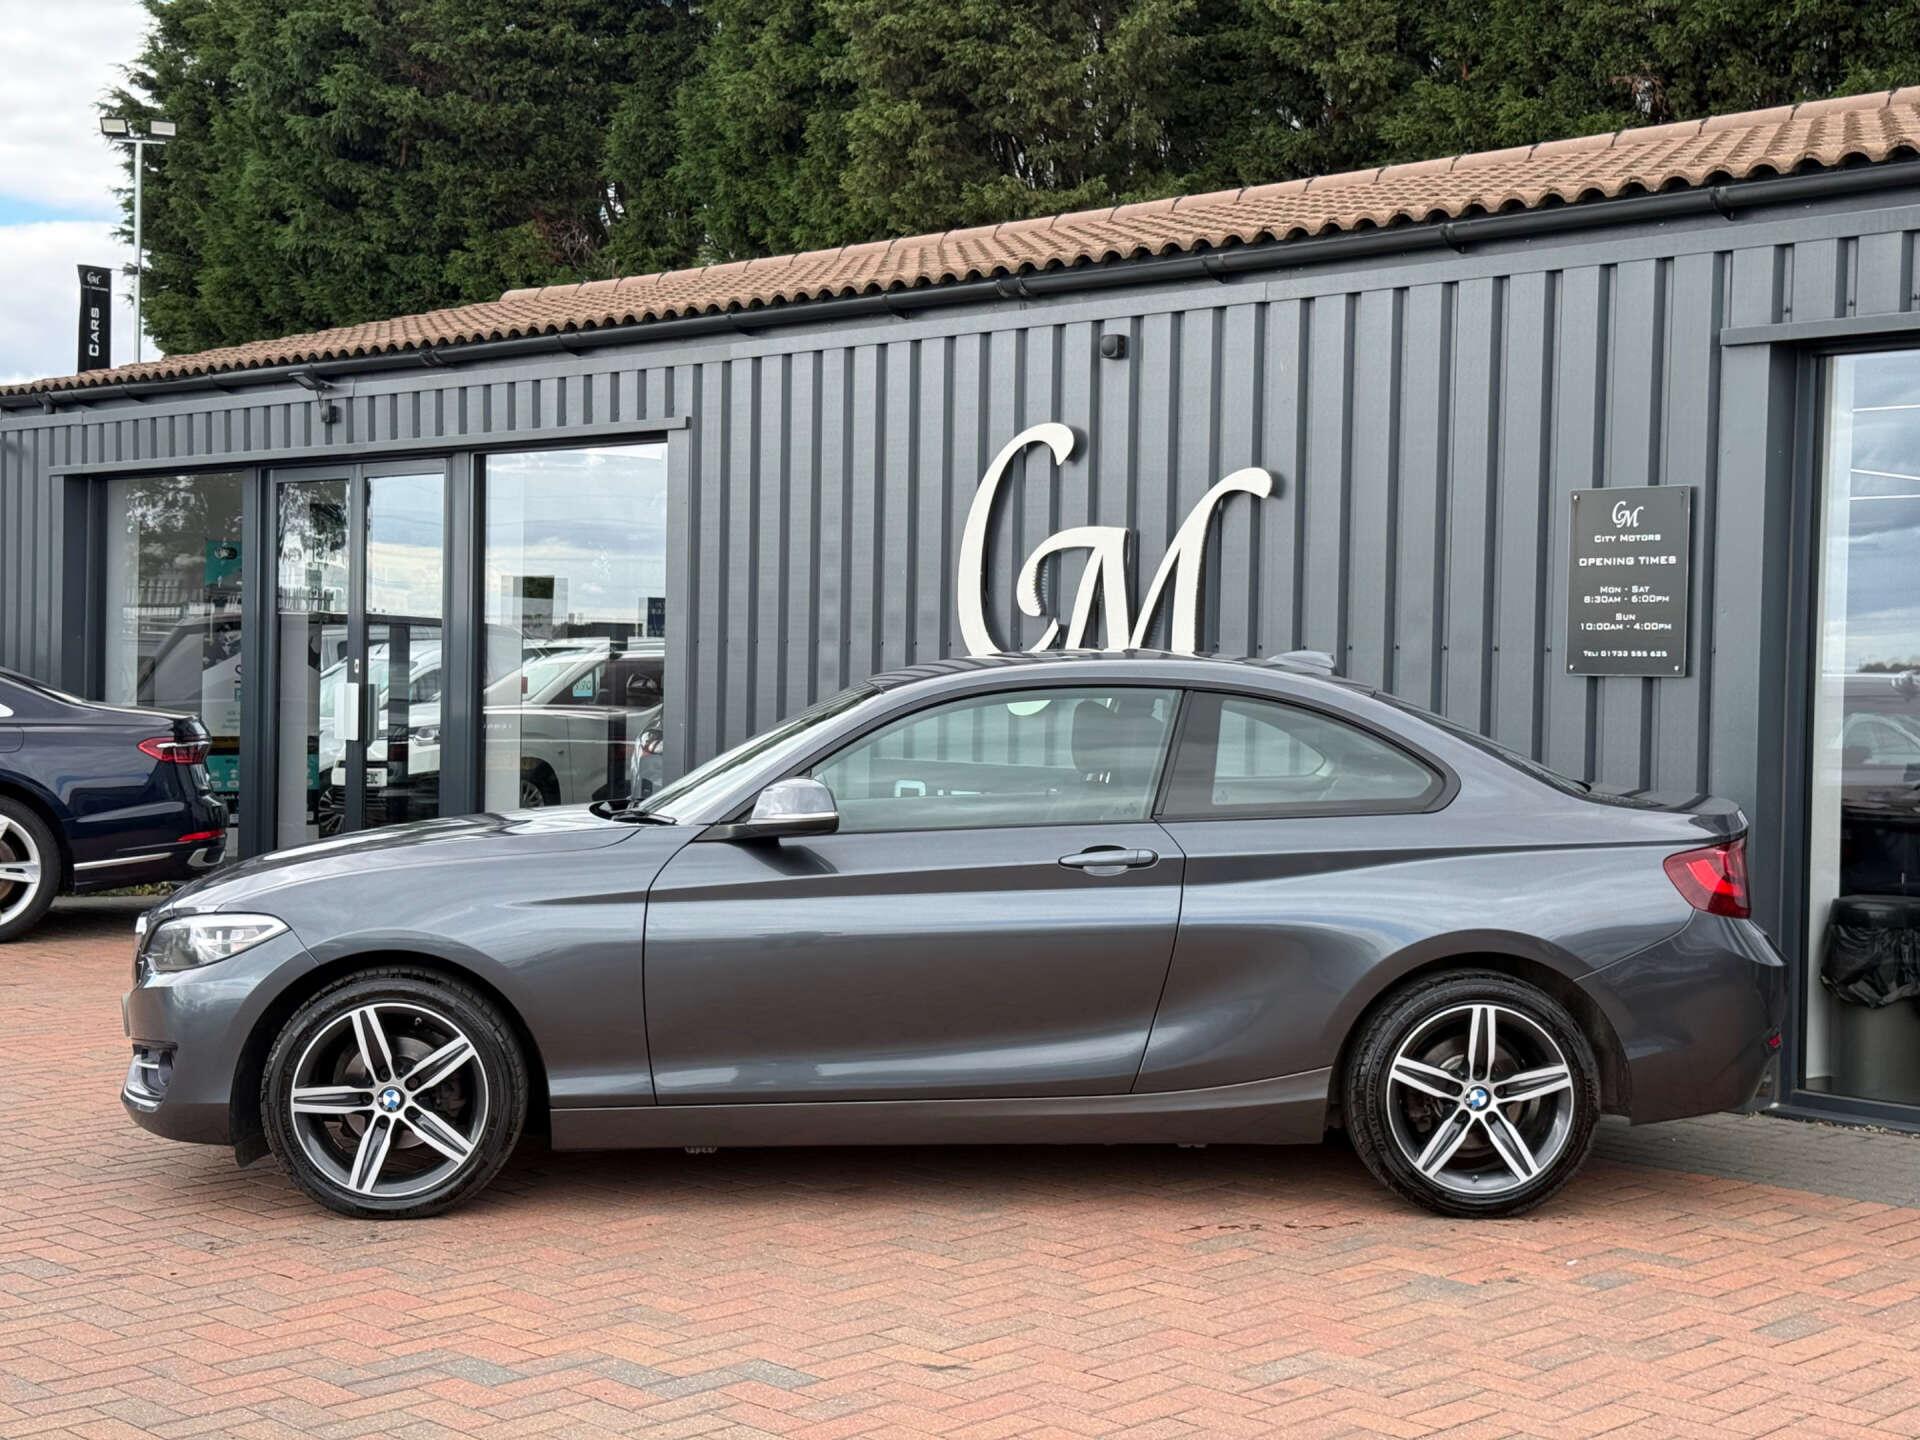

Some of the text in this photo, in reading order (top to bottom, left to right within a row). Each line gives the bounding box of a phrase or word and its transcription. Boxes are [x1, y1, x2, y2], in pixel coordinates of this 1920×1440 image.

[88, 307, 100, 357] CARS
[1578, 555, 1677, 567] OPENING TIMES
